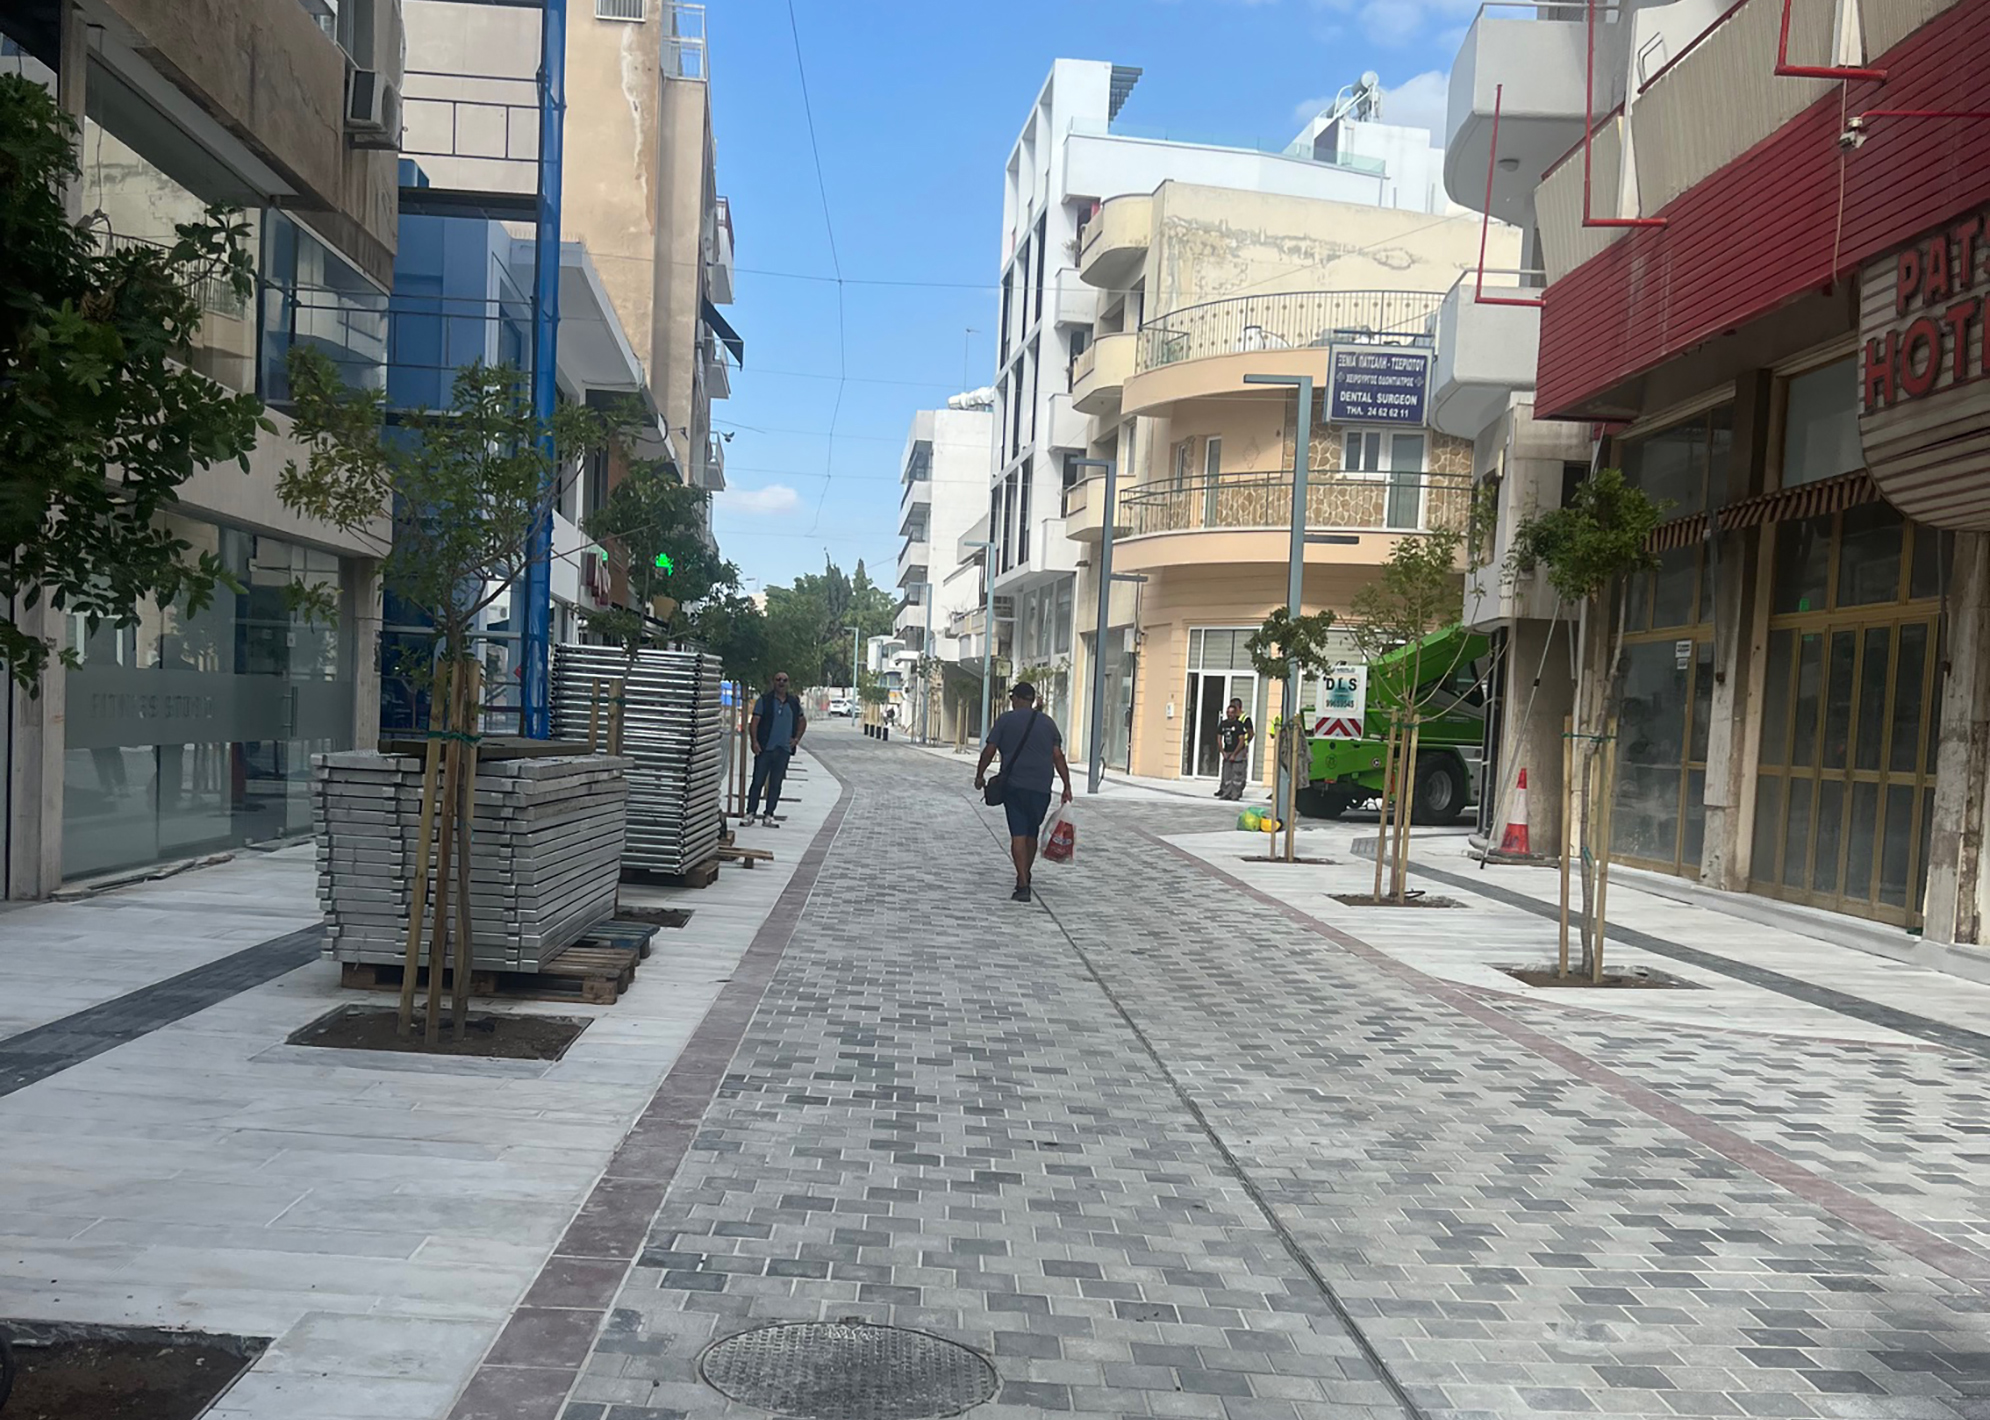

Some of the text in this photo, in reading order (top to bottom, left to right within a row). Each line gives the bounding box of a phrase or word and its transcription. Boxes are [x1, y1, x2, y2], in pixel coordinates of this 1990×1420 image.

[1896, 218, 1990, 316] PAT
[1340, 391, 1418, 406] DENTAL SURGEON
[1367, 407, 1377, 416] 24
[1400, 408, 1409, 418] 11
